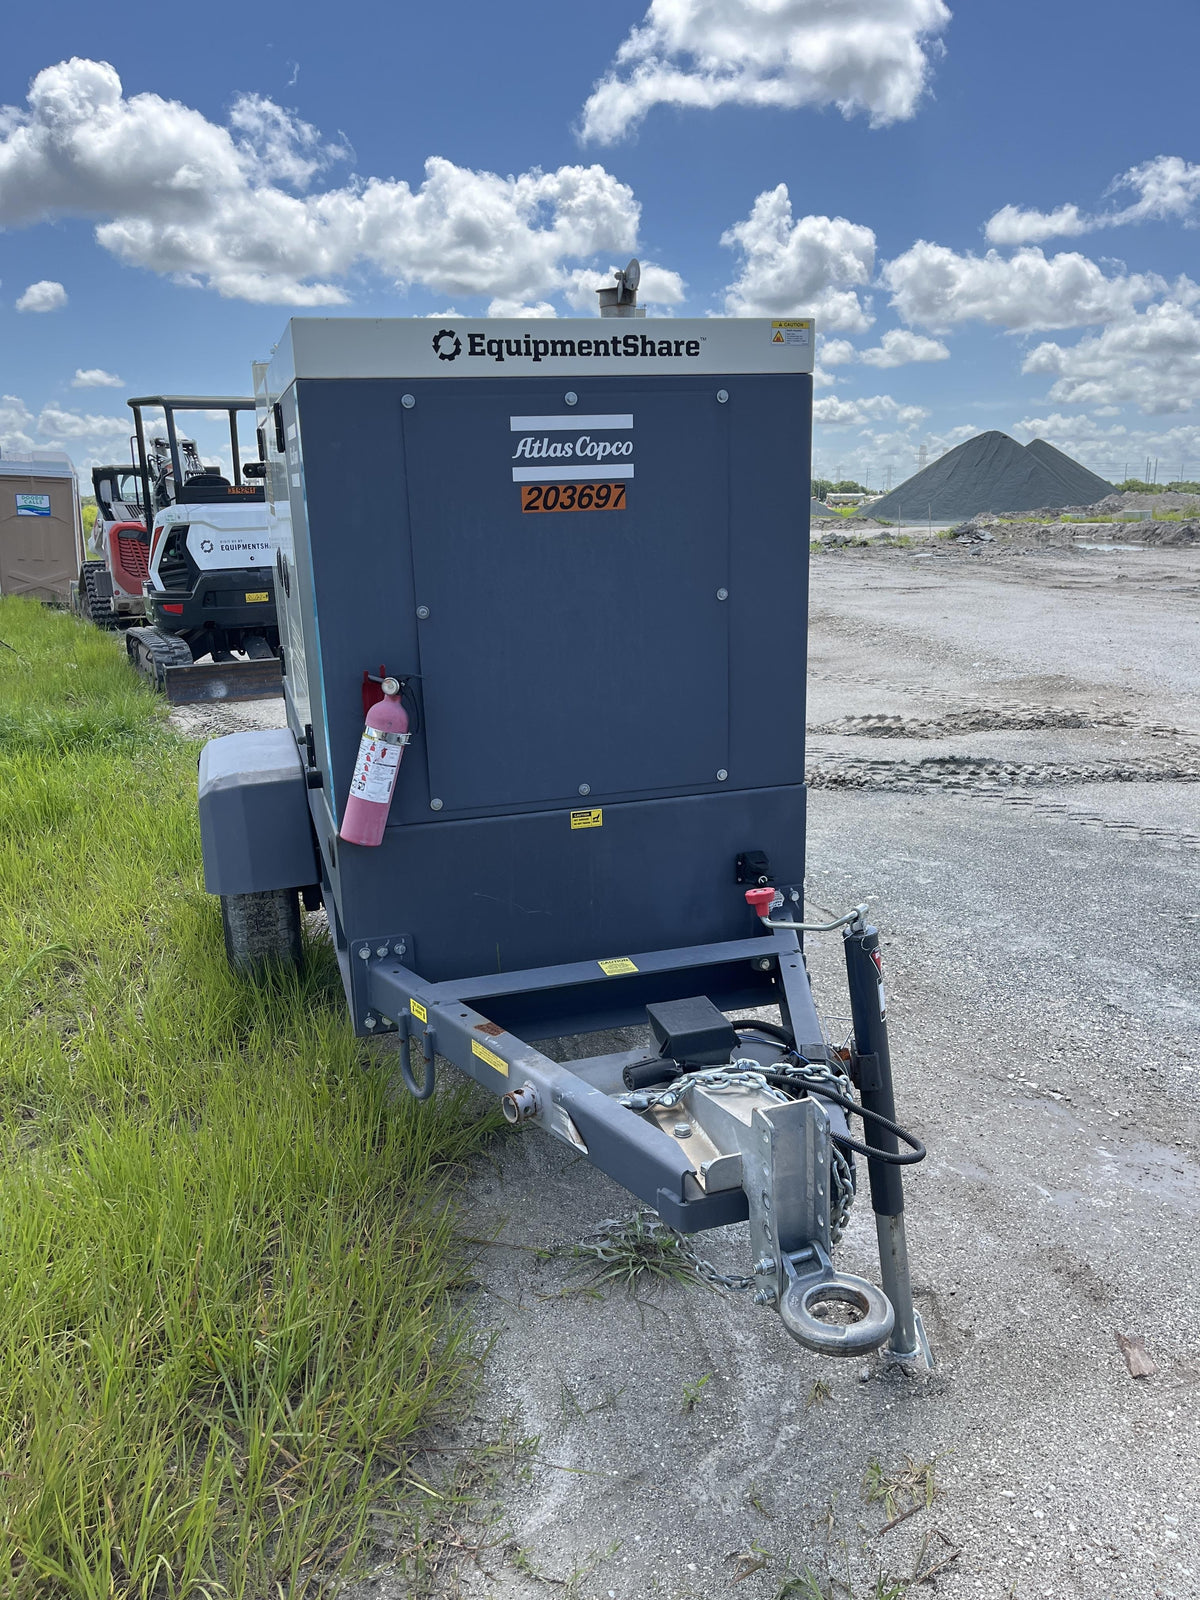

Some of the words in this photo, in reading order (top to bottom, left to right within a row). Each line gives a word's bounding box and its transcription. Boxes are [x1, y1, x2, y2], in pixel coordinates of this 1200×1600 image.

[467, 333, 700, 362] EquipmentShare
[512, 437, 573, 459] Atlas
[575, 436, 634, 460] Copco
[523, 484, 626, 511] 203697
